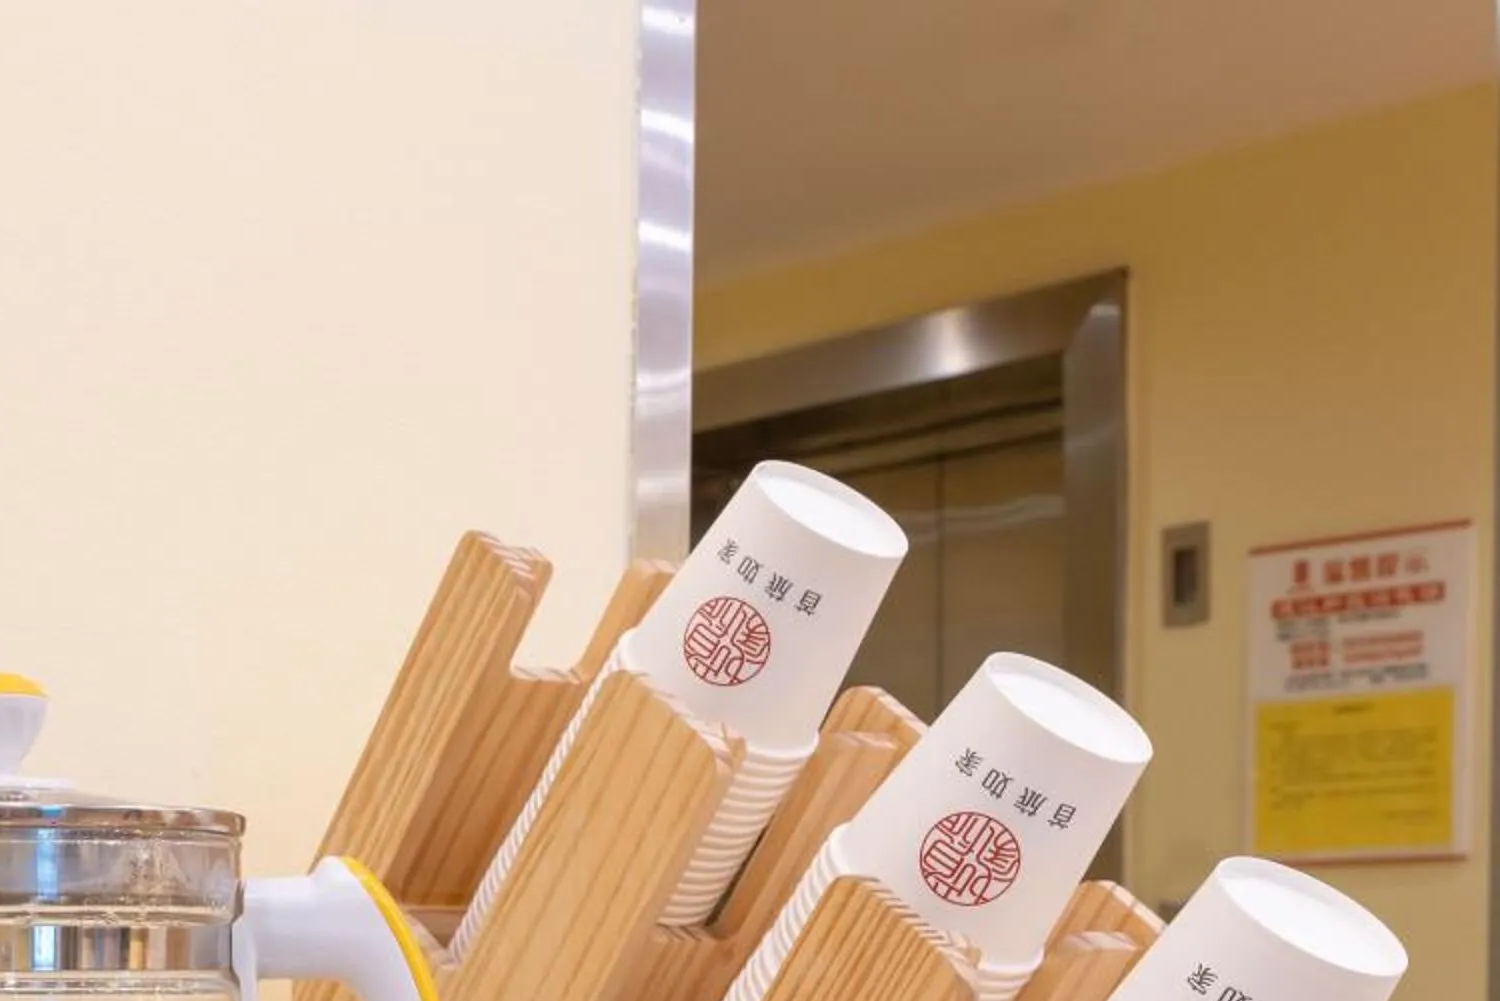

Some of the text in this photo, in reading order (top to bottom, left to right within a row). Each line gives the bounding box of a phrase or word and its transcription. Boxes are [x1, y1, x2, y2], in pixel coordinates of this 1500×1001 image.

[717, 537, 821, 616] 首旅如家
[955, 748, 1077, 829] 首旅如家
